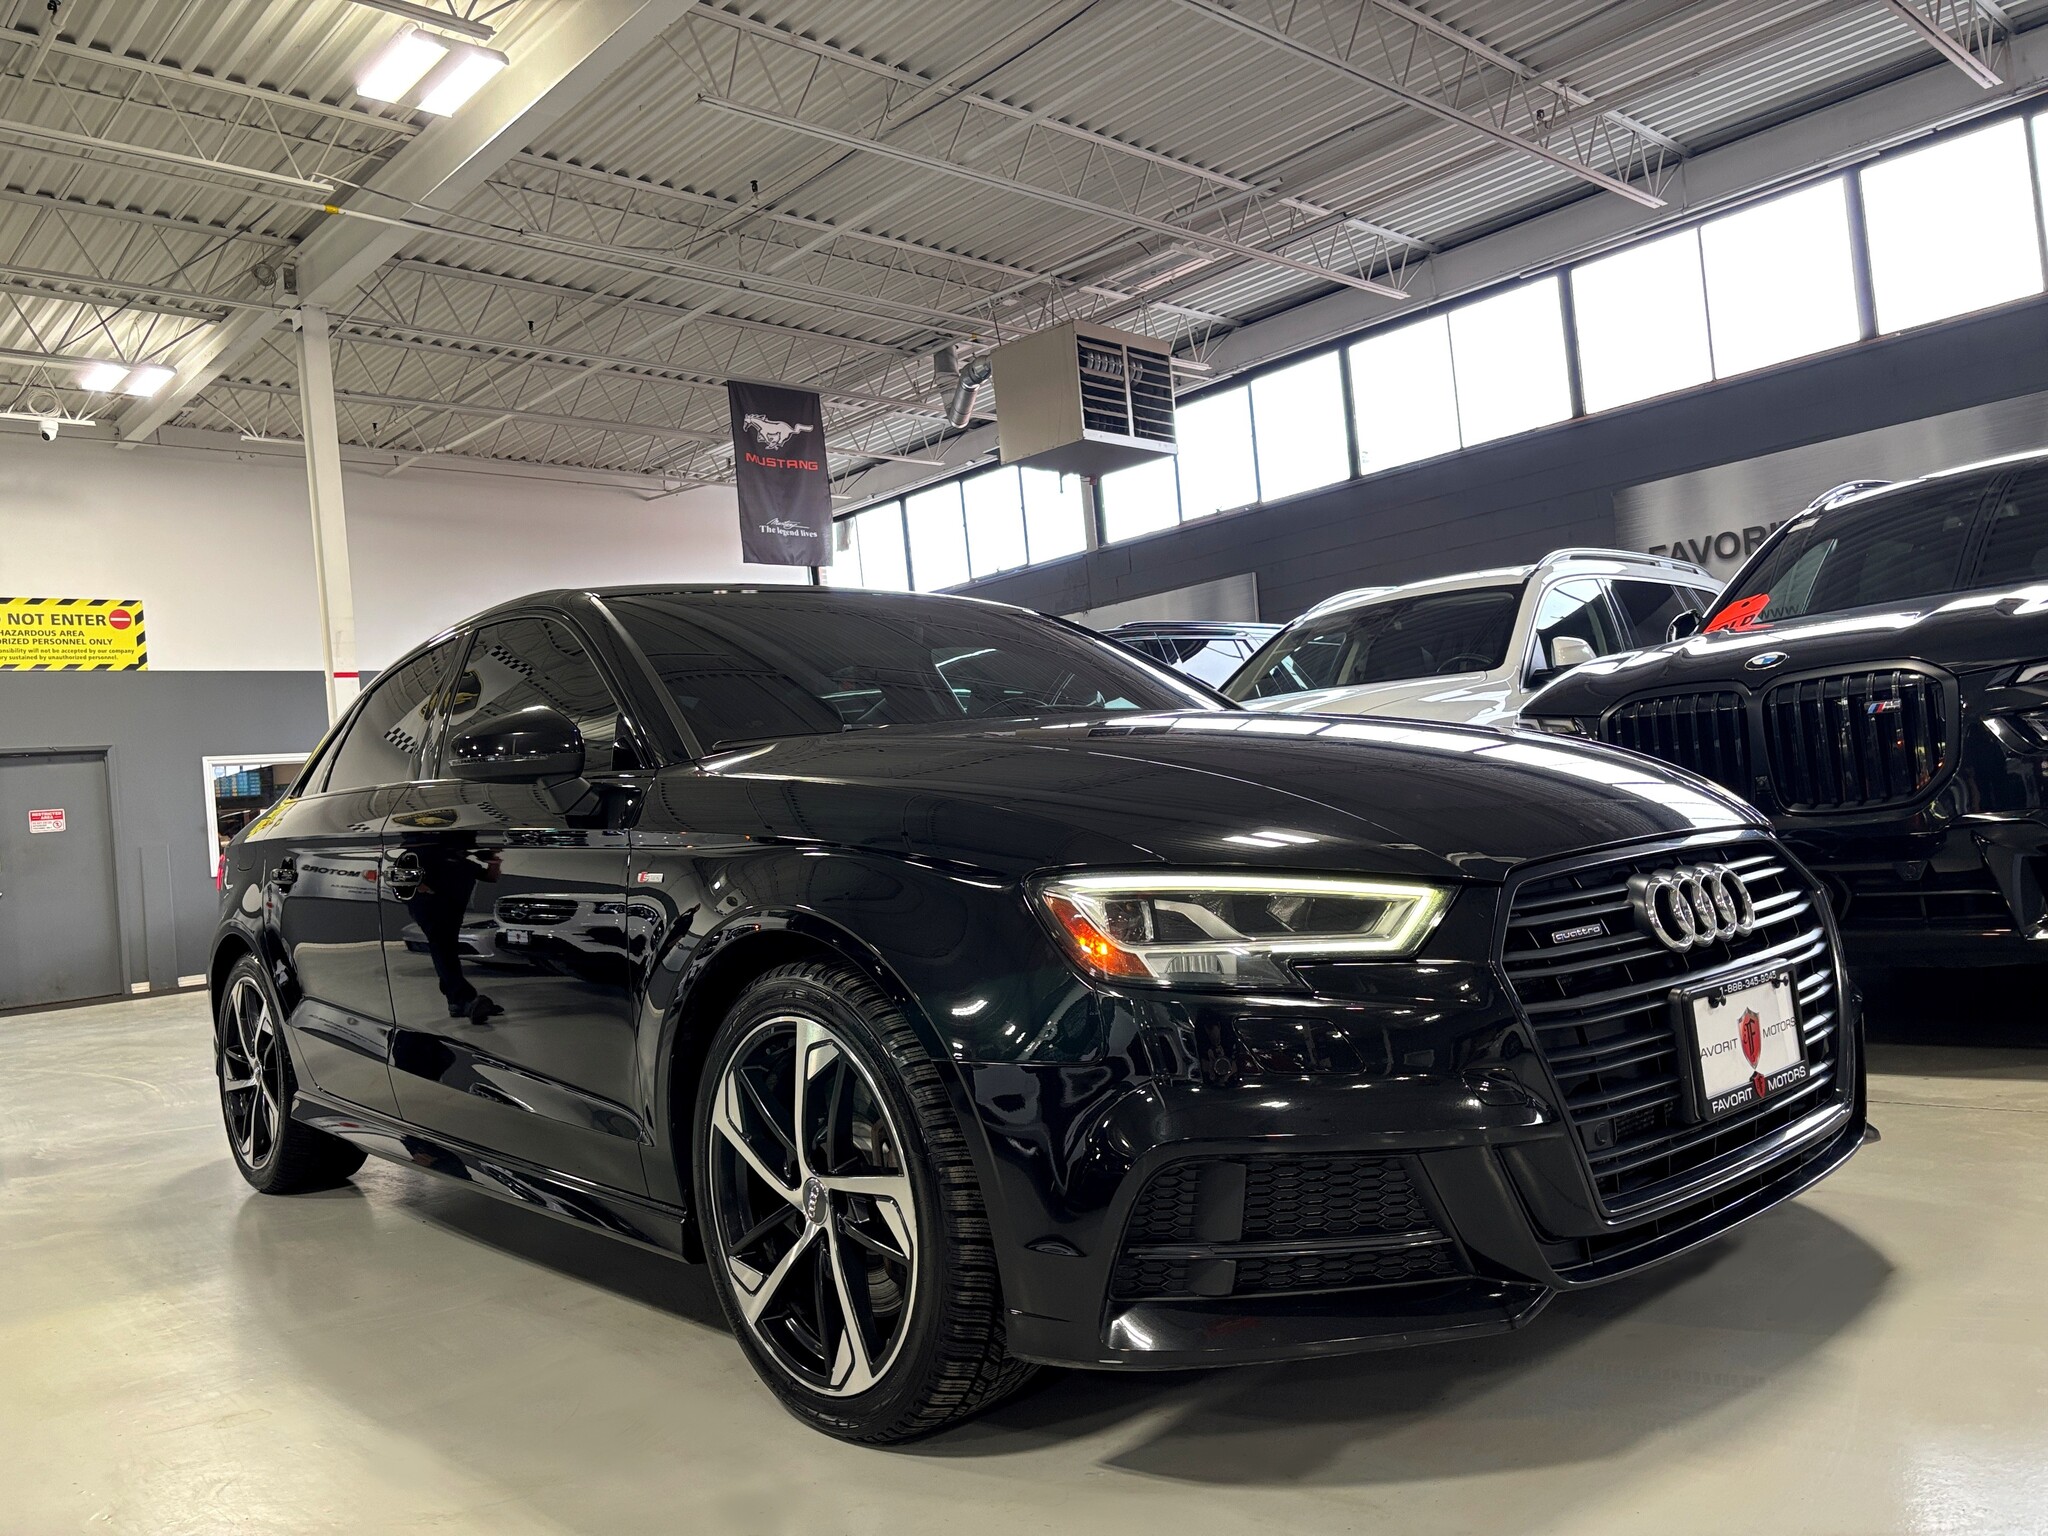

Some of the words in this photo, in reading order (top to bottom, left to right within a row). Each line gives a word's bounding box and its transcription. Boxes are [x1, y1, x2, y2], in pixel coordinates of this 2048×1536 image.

[745, 452, 819, 471] MUSTANG
[759, 525, 776, 534] The
[777, 527, 799, 537] legend
[800, 530, 818, 538] lives
[8, 613, 44, 625] NOT
[51, 614, 107, 626] ENTER
[1555, 926, 1601, 941] quattro
[1762, 1016, 1796, 1038] MOTORS
[1712, 1088, 1753, 1114] FAVORIT
[1767, 1066, 1806, 1091] MOTORS
